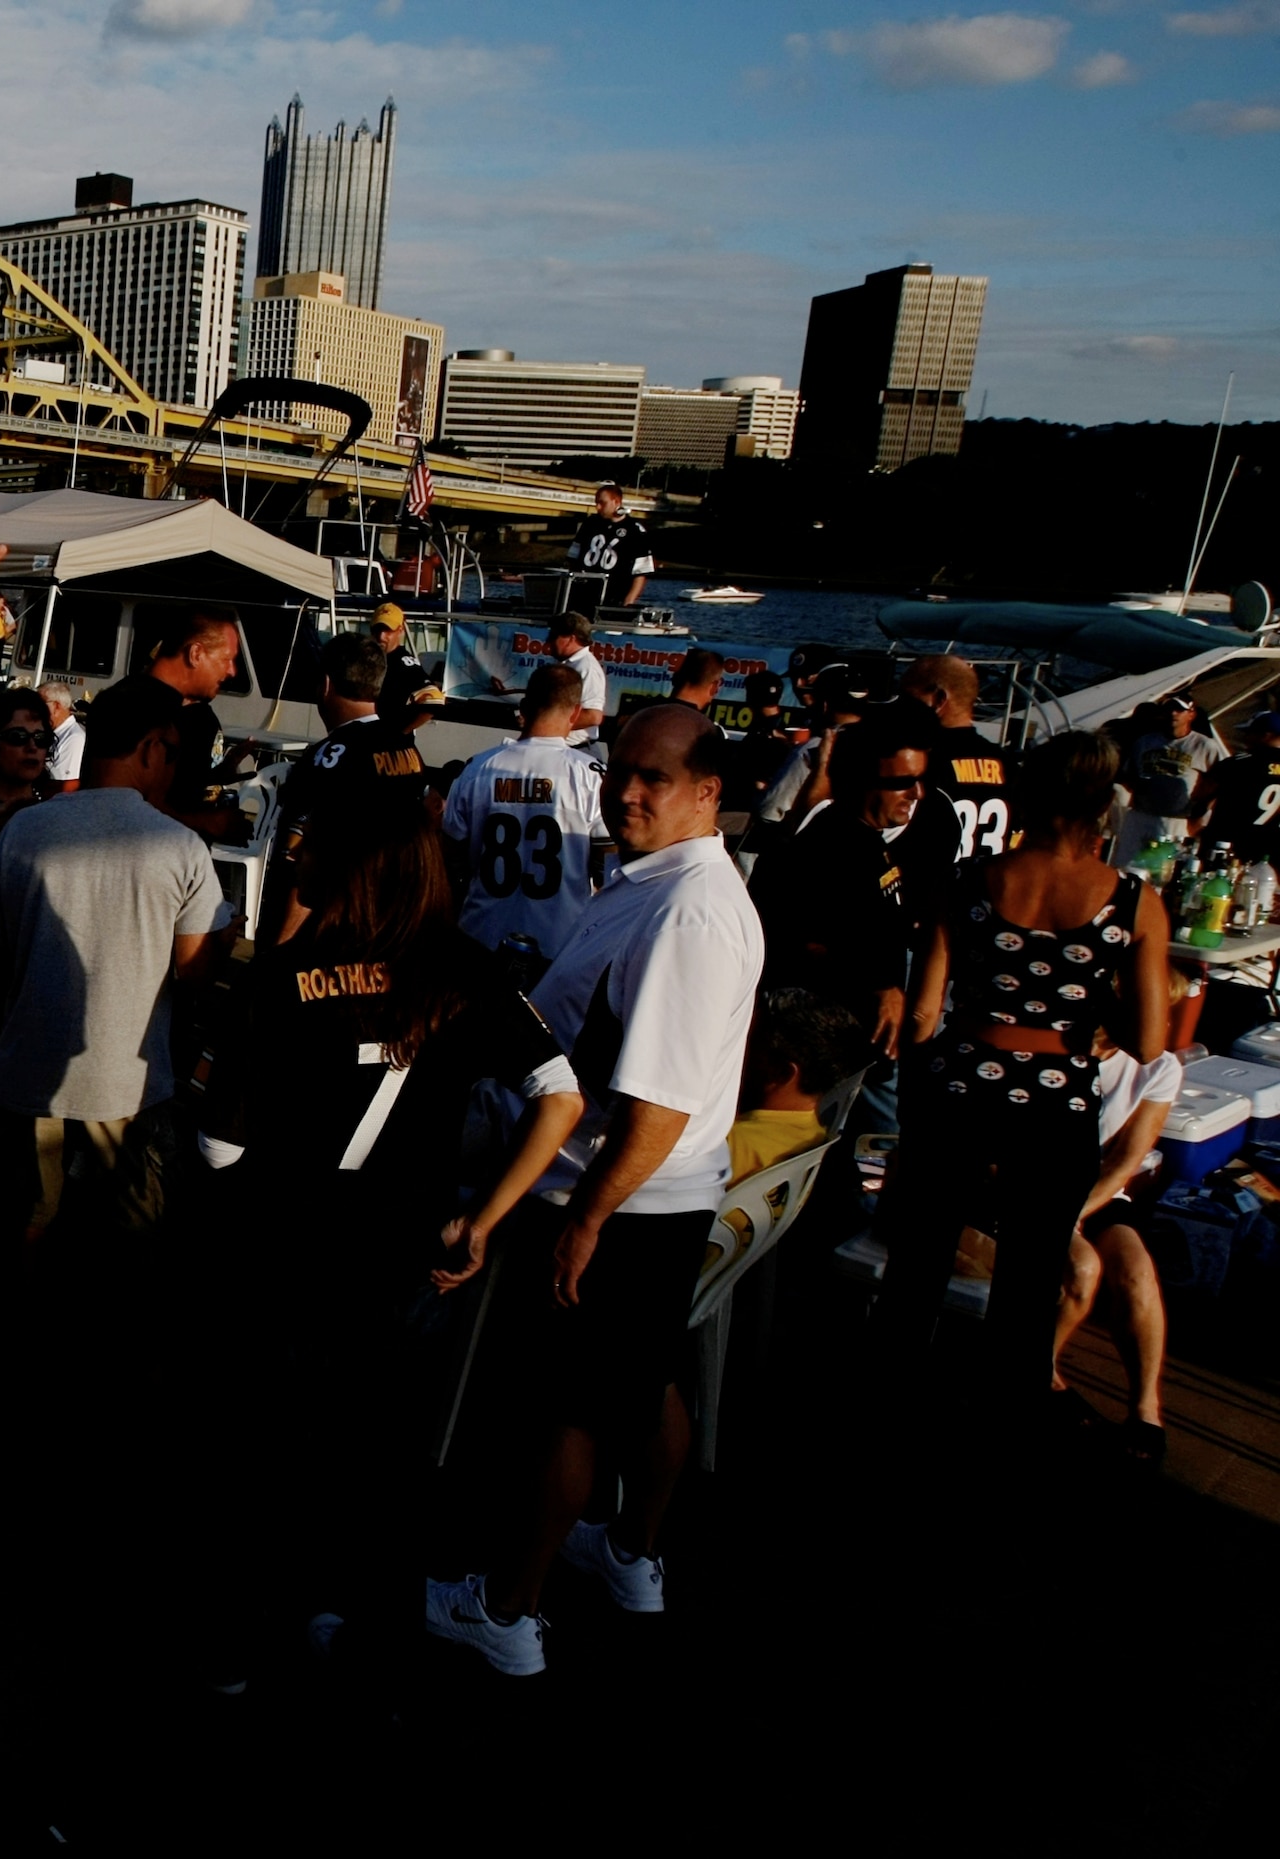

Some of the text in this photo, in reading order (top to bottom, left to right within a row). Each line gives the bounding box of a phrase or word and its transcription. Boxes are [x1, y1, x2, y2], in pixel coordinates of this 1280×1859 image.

[583, 533, 620, 570] 86
[494, 778, 553, 804] MILLER
[480, 812, 563, 900] 83
[337, 1042, 412, 1172] 7
